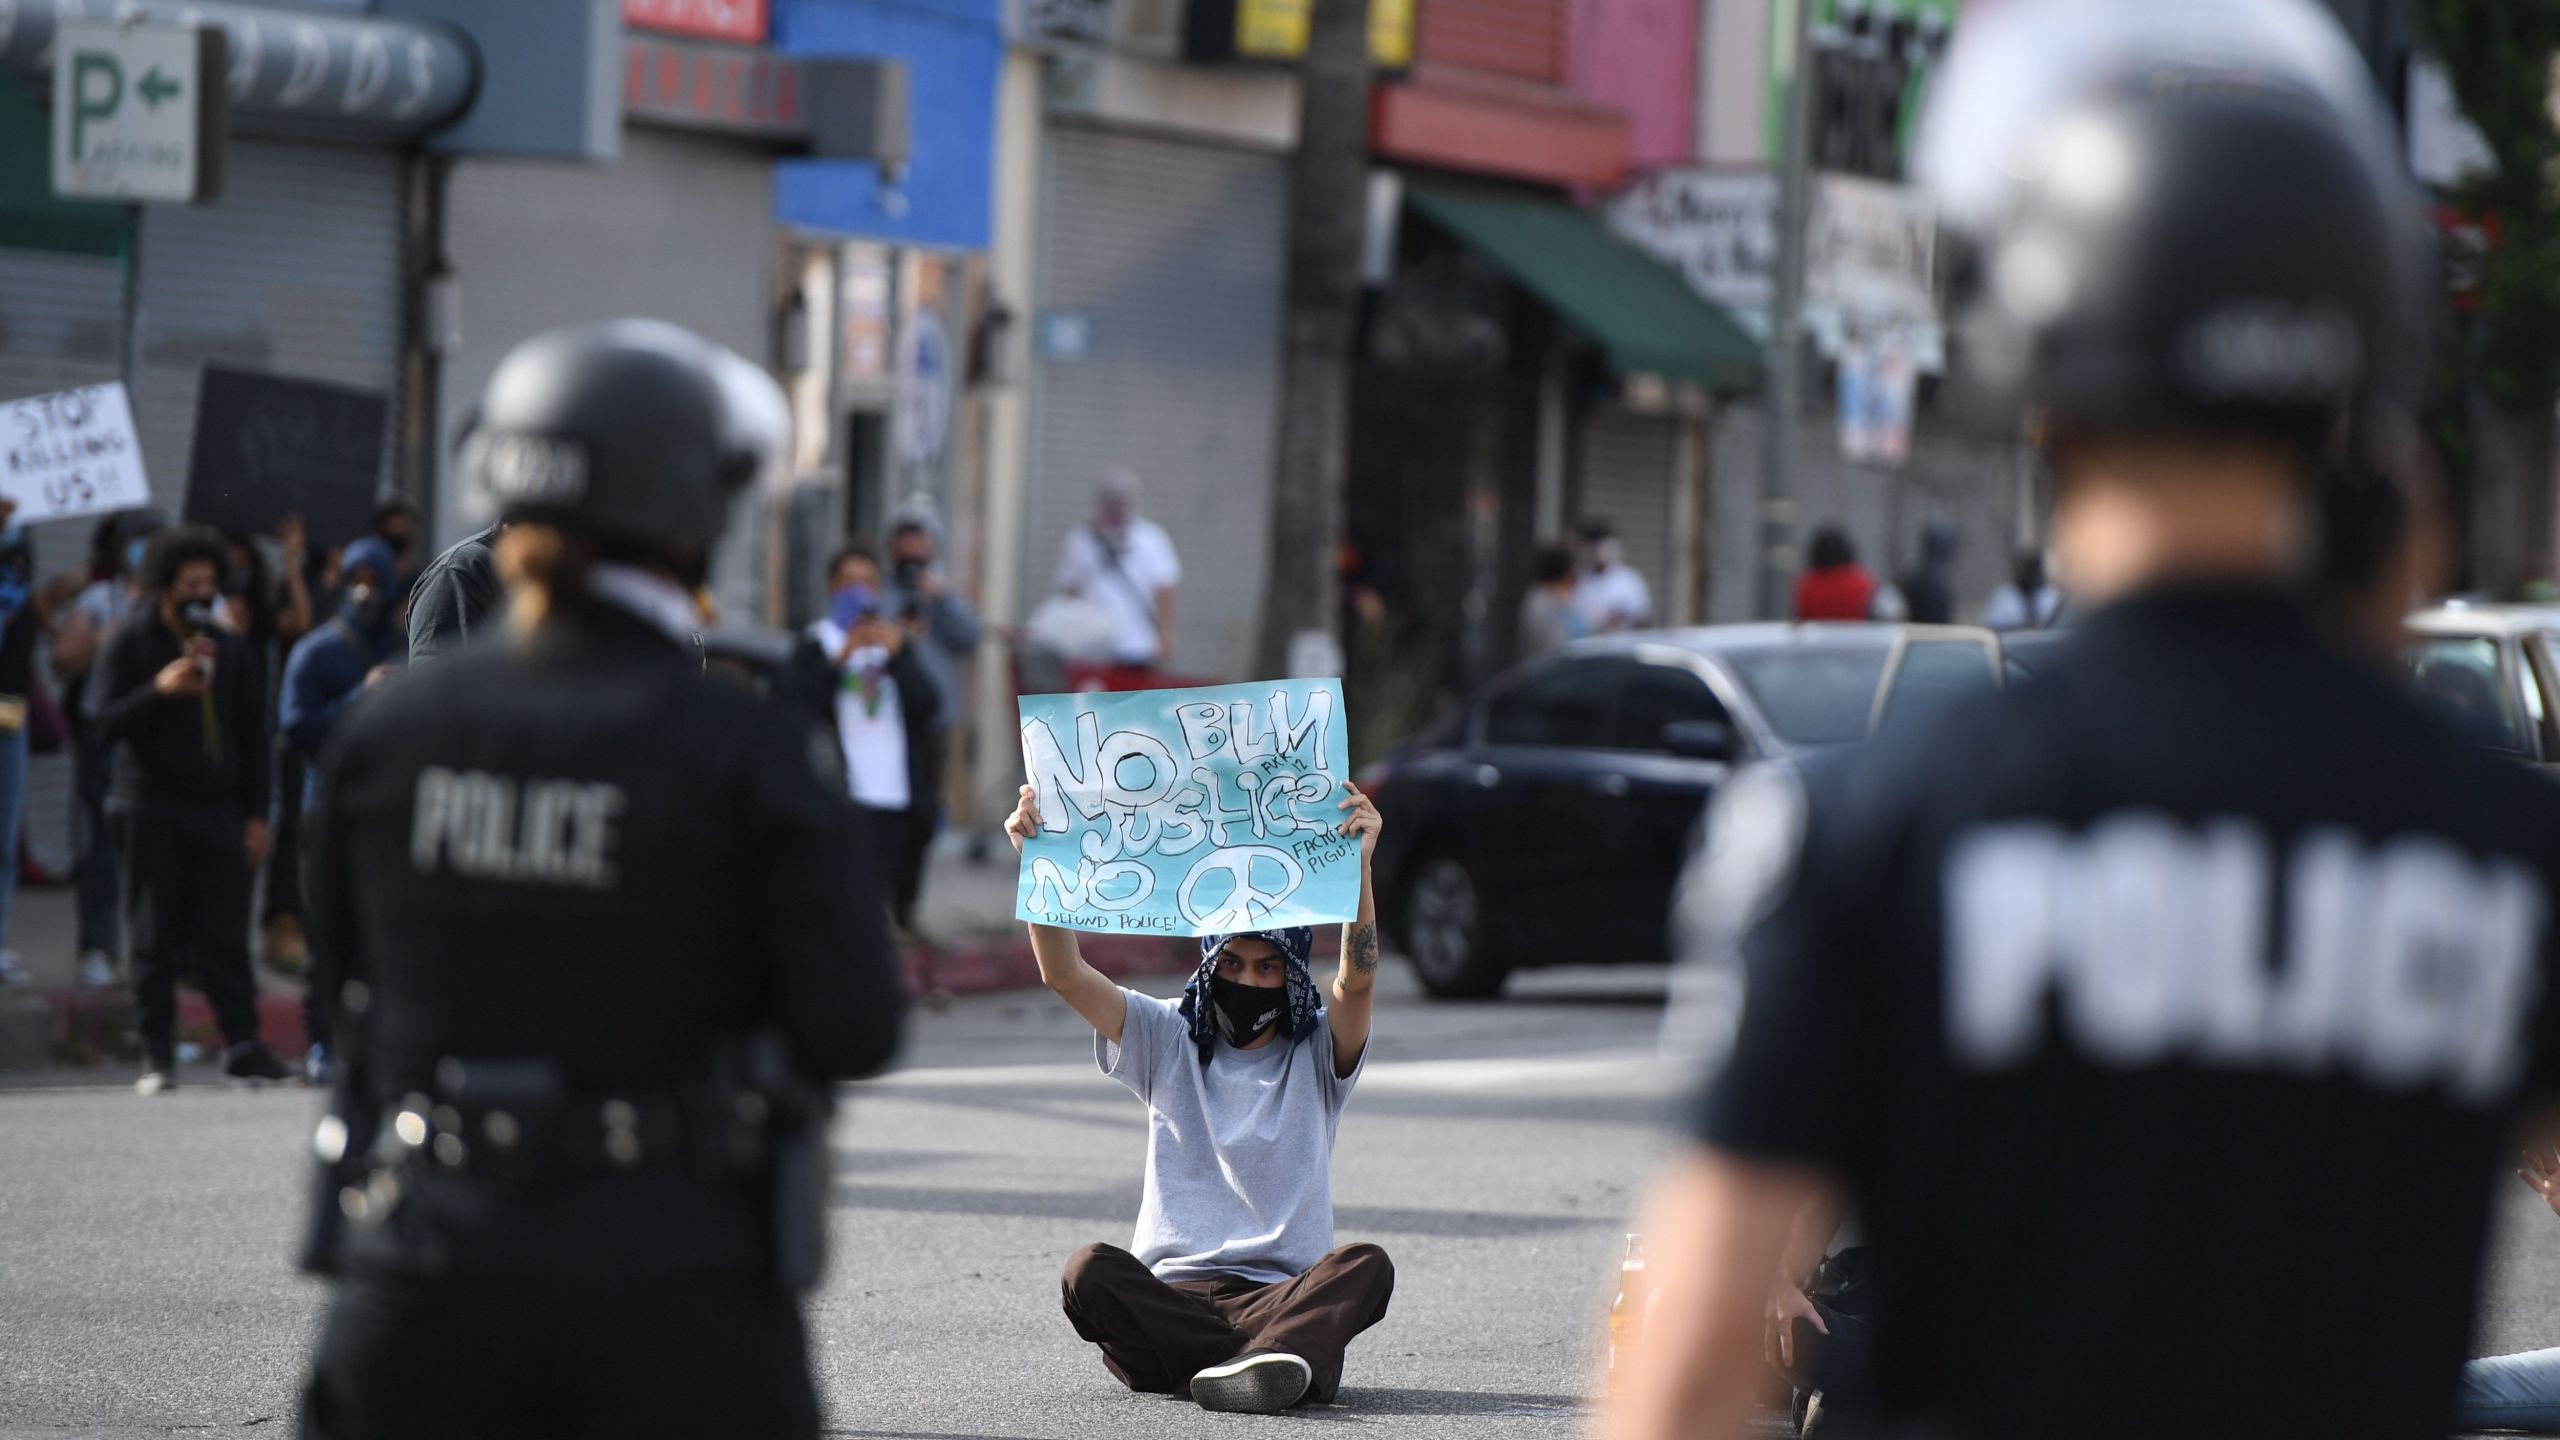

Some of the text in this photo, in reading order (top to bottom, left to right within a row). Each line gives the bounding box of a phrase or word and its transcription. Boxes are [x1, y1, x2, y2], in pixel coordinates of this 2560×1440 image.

[13, 388, 101, 447] STOP
[9, 426, 127, 474] KILLING
[1176, 689, 1333, 770] BLM
[1021, 710, 1178, 834] NO
[1292, 758, 1308, 773] 12
[410, 766, 627, 889] POLICE
[1025, 855, 1156, 914] NO
[1046, 911, 1109, 929] DEFUND
[1257, 1007, 1280, 1024] NIKE
